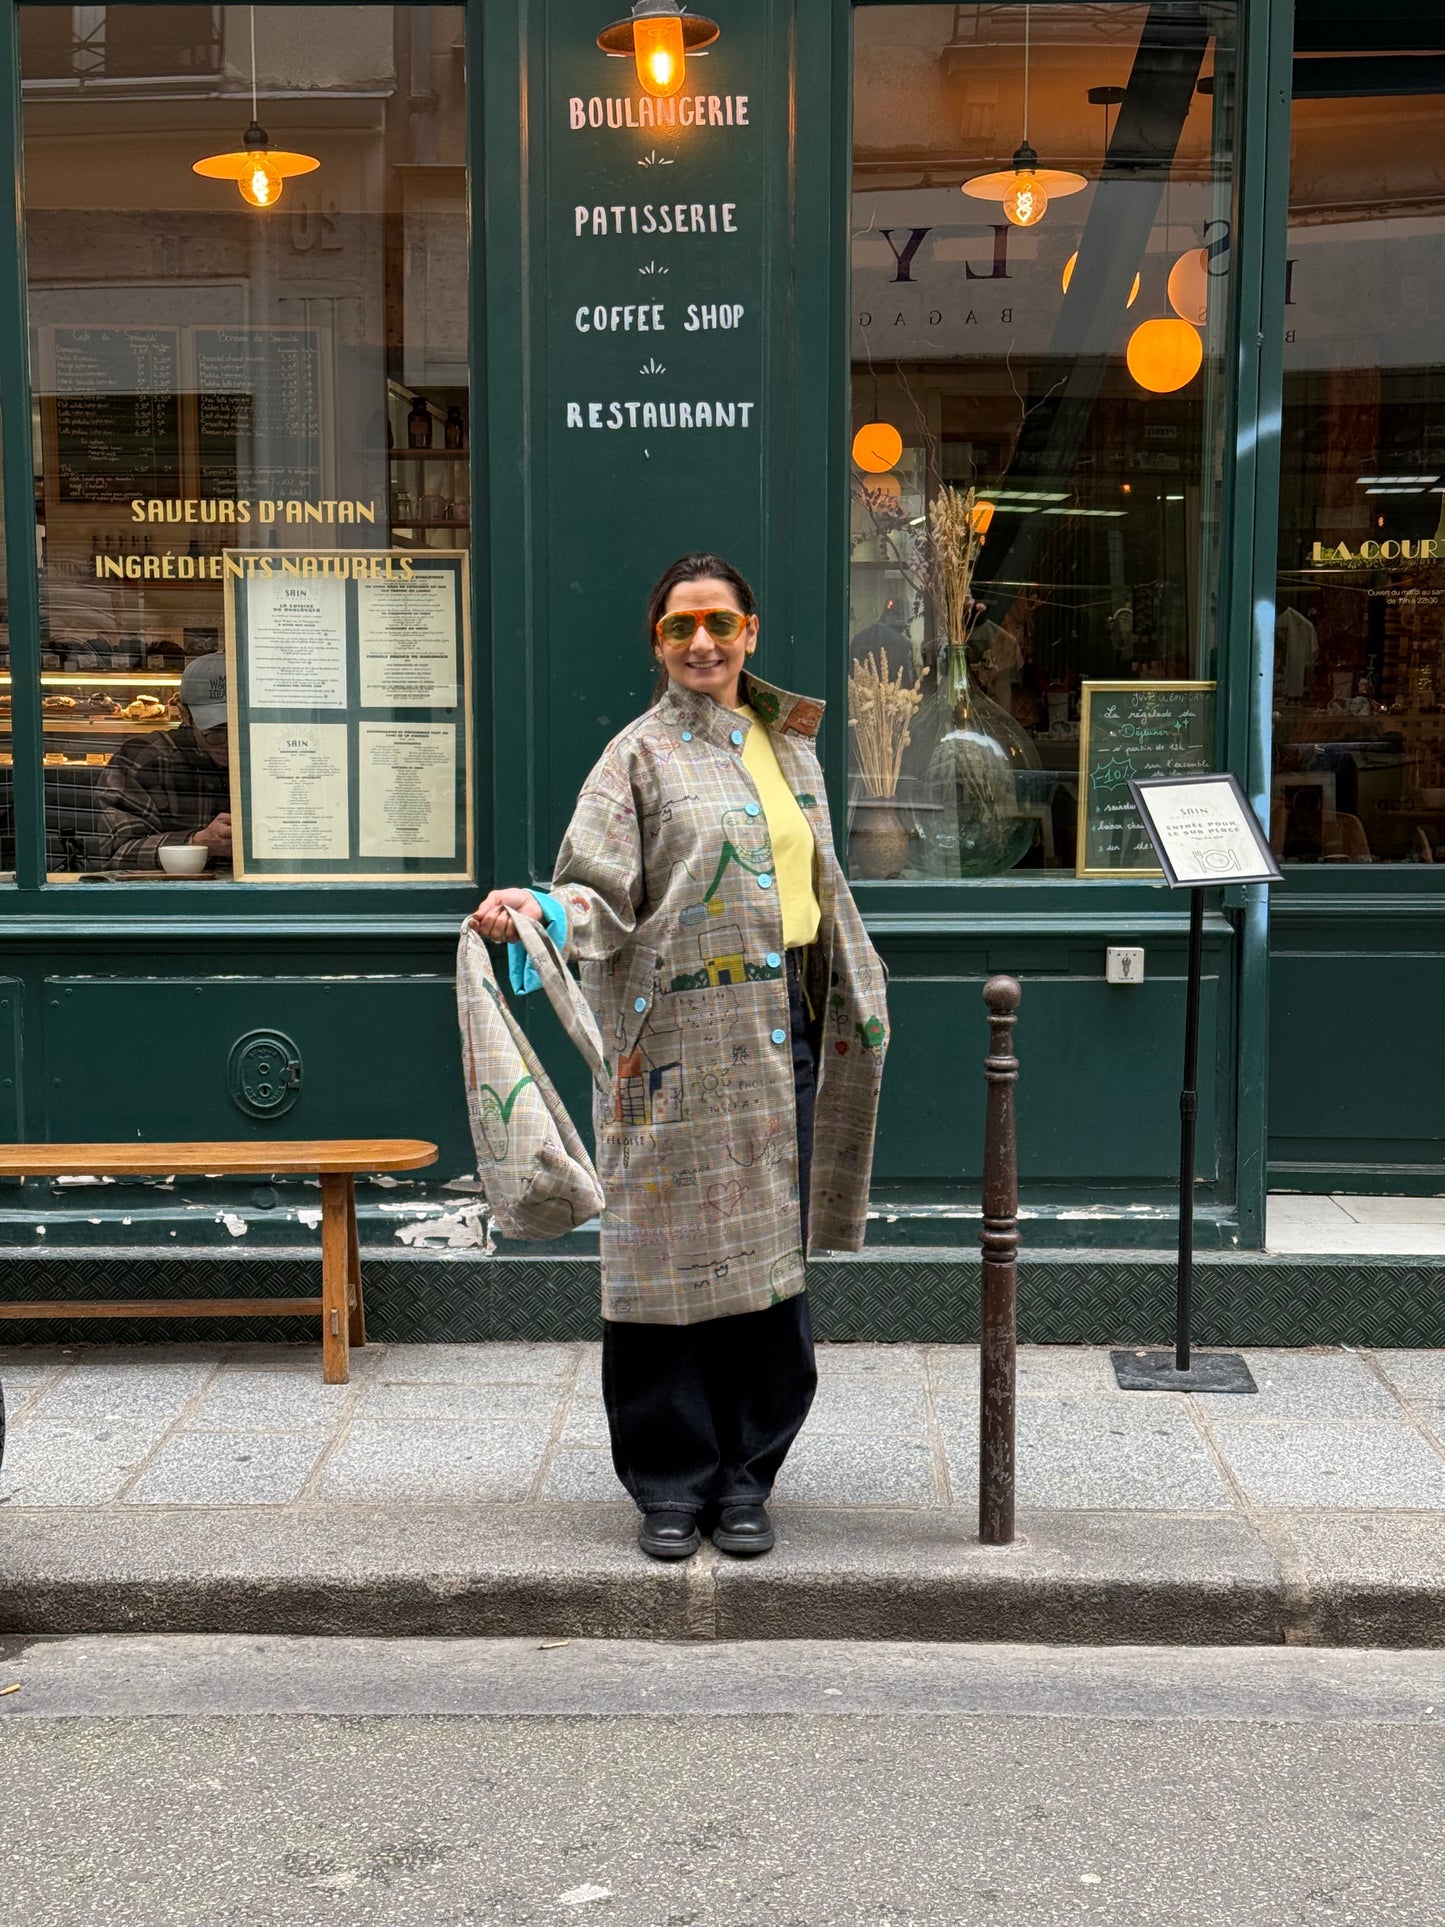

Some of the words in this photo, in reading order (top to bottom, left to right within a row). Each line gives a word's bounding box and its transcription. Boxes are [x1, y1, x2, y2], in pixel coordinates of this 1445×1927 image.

[569, 96, 749, 130] BOULANGERIE
[574, 203, 738, 236] PATISSERIE
[575, 304, 665, 333] COFFEE
[683, 304, 745, 332] SHOP
[566, 402, 755, 429] RESTAURANT
[131, 500, 251, 524] SAVEURS
[259, 500, 375, 524] D'ANTAN
[1313, 540, 1353, 561] LA
[1360, 539, 1445, 560] COUR
[95, 551, 274, 580] INGRÉDIENTS
[281, 556, 414, 581] NATURELS
[284, 589, 308, 598] SAIN
[1367, 589, 1390, 597] Ouvert
[286, 740, 309, 748] SAIN
[1121, 723, 1170, 743] Déjeuner
[1179, 807, 1209, 816] SAIN
[1166, 822, 1203, 831] ENTRÉE
